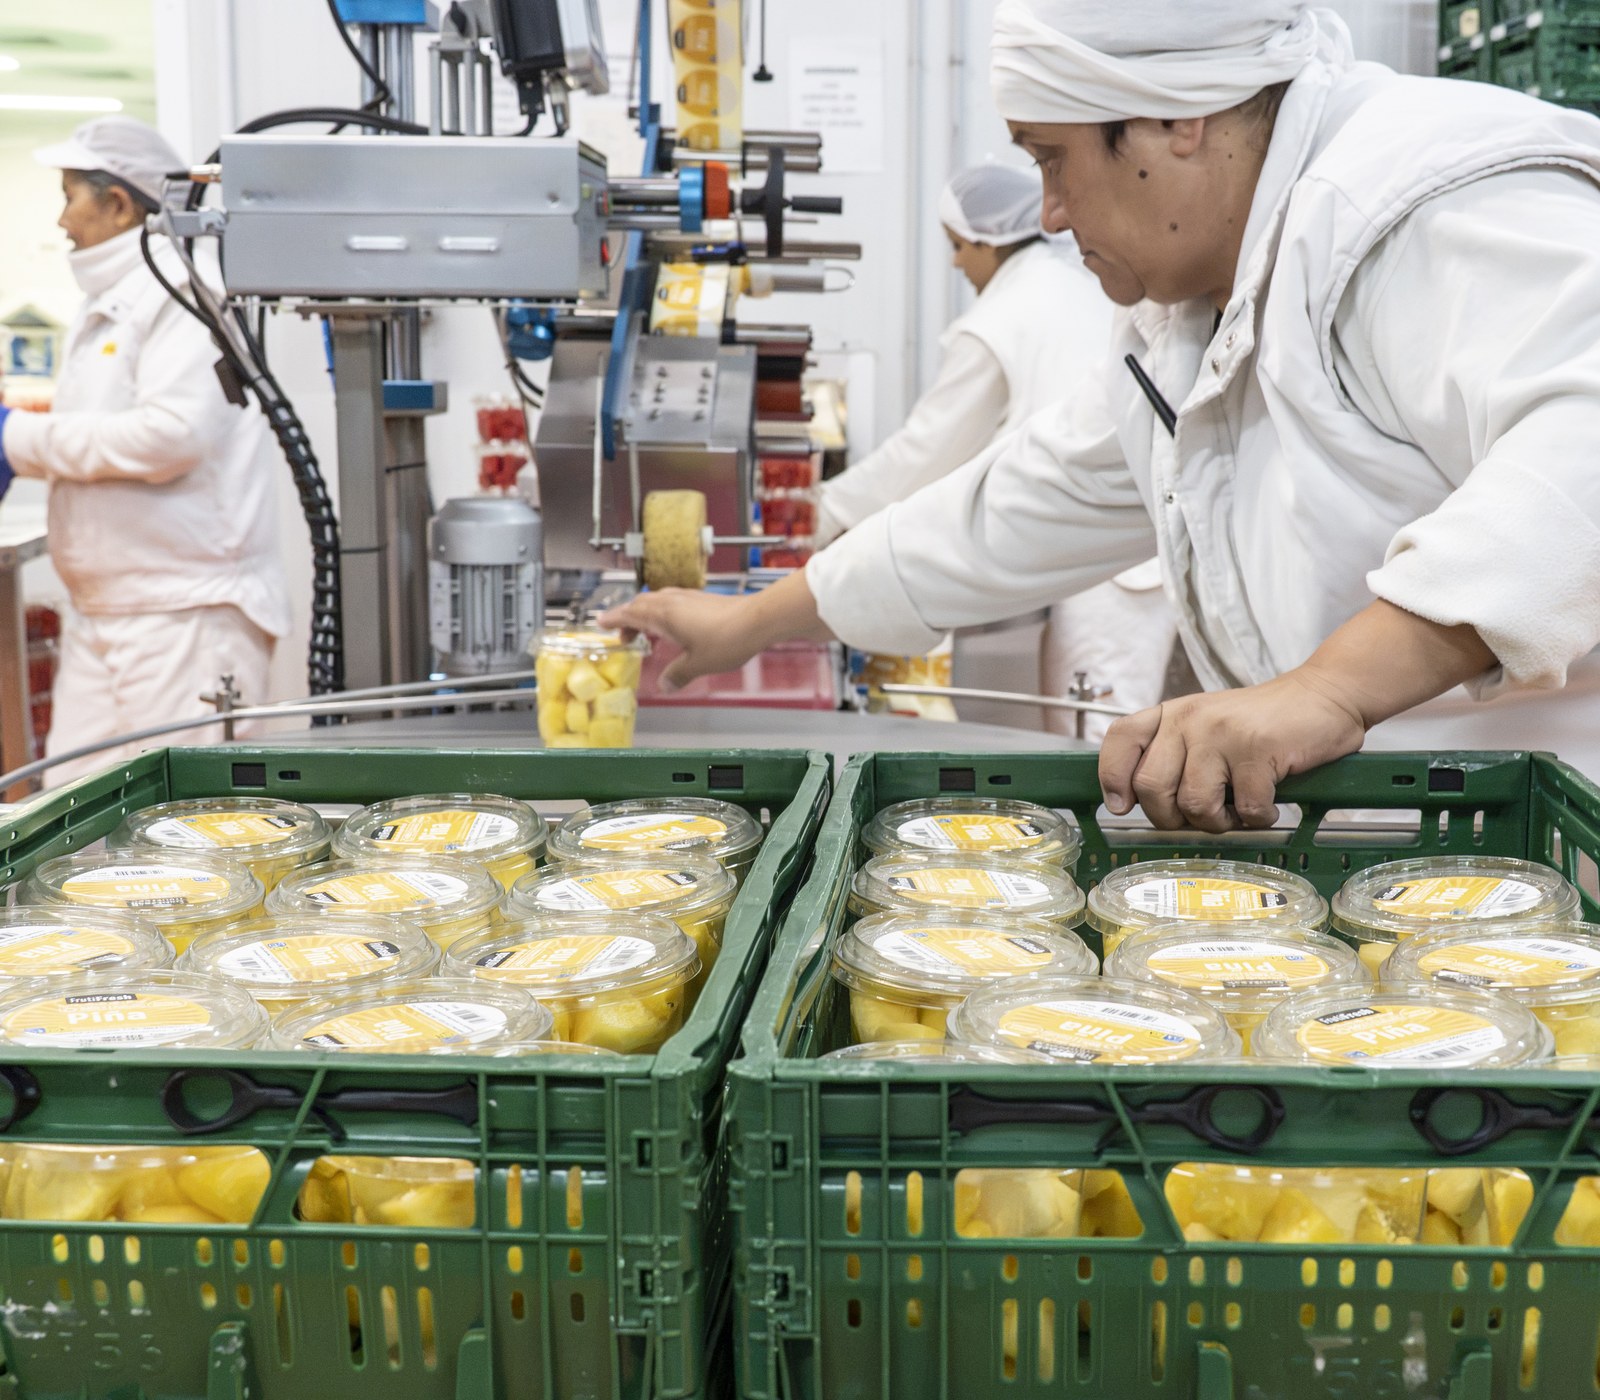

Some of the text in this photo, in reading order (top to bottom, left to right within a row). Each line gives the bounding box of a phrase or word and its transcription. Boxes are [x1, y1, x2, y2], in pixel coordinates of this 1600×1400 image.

[114, 883, 180, 892] Piña
[1203, 962, 1276, 972] Piña
[1474, 955, 1540, 972] Piña
[67, 1011, 147, 1024] Piña
[1059, 1021, 1134, 1044] Piña
[1351, 1023, 1430, 1044] Piña
